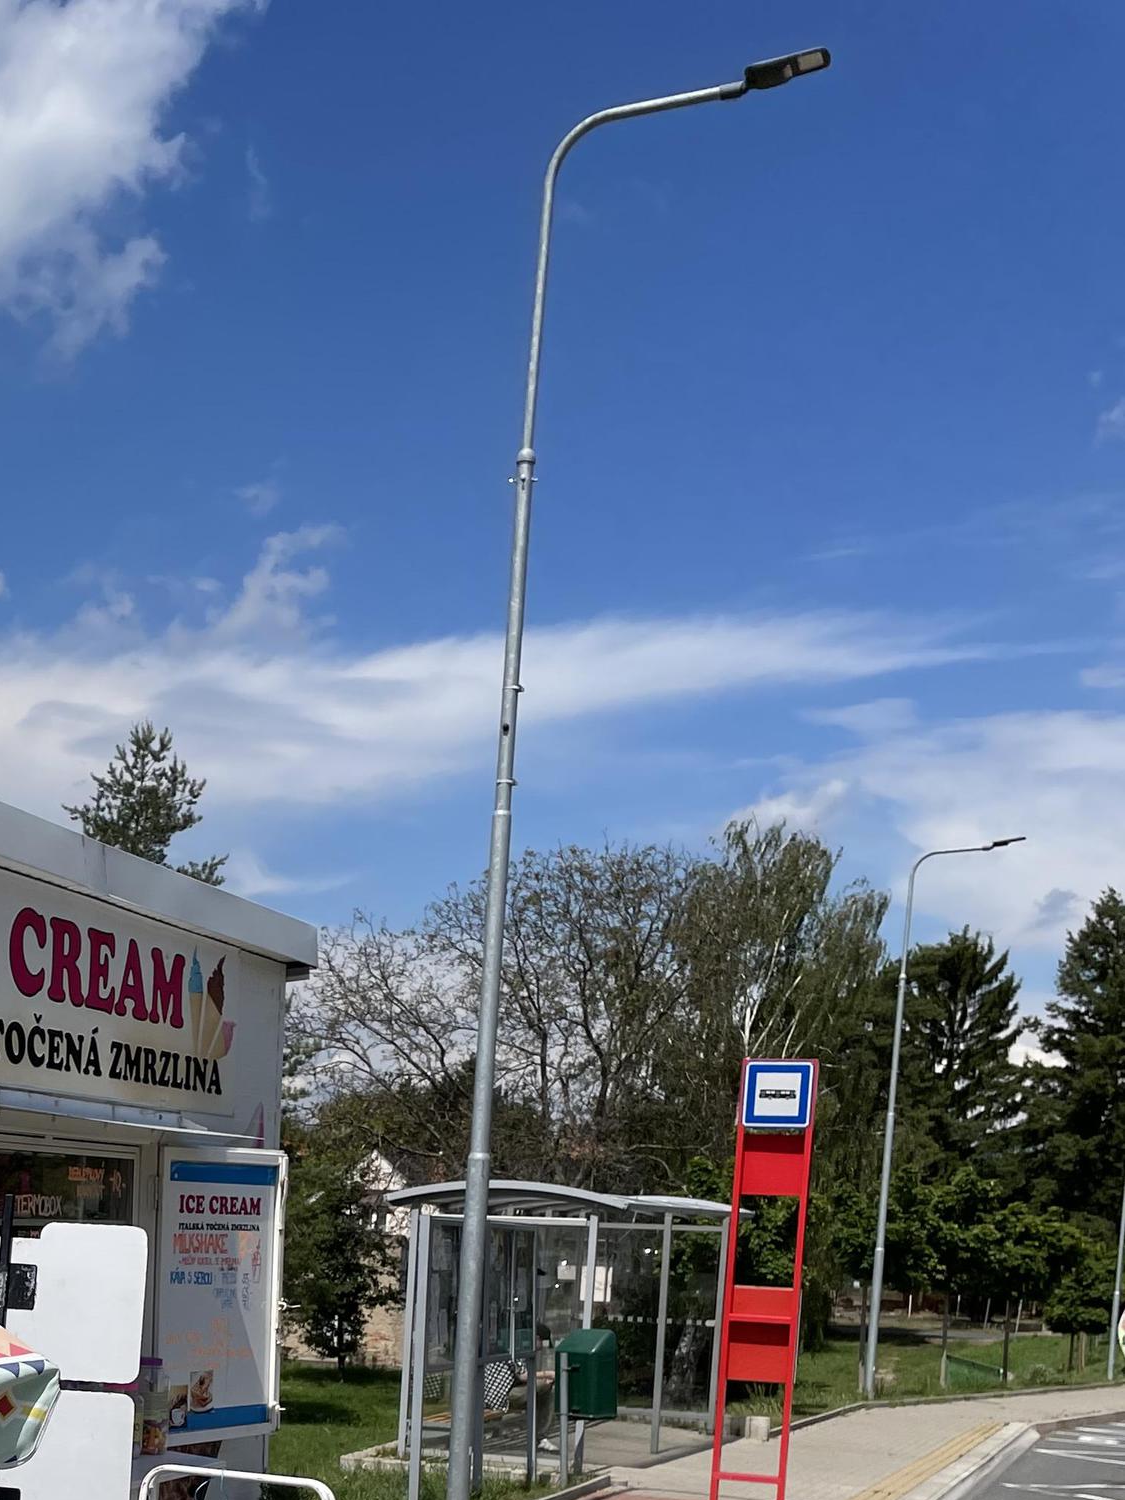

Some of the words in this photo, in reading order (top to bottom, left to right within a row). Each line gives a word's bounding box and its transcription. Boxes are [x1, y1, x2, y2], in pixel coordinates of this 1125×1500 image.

[9, 907, 186, 1029] CREAM
[109, 1041, 223, 1096] ZMRZLINA
[15, 1194, 63, 1217] TERMOBOX
[179, 1194, 205, 1214] ICE
[209, 1196, 261, 1216] CREAM
[179, 1221, 205, 1231] ITALSKÁ
[206, 1222, 229, 1231] TOČENÁ
[231, 1223, 260, 1232] ZMRZLINA
[172, 1232, 228, 1254] MILKSHAKE
